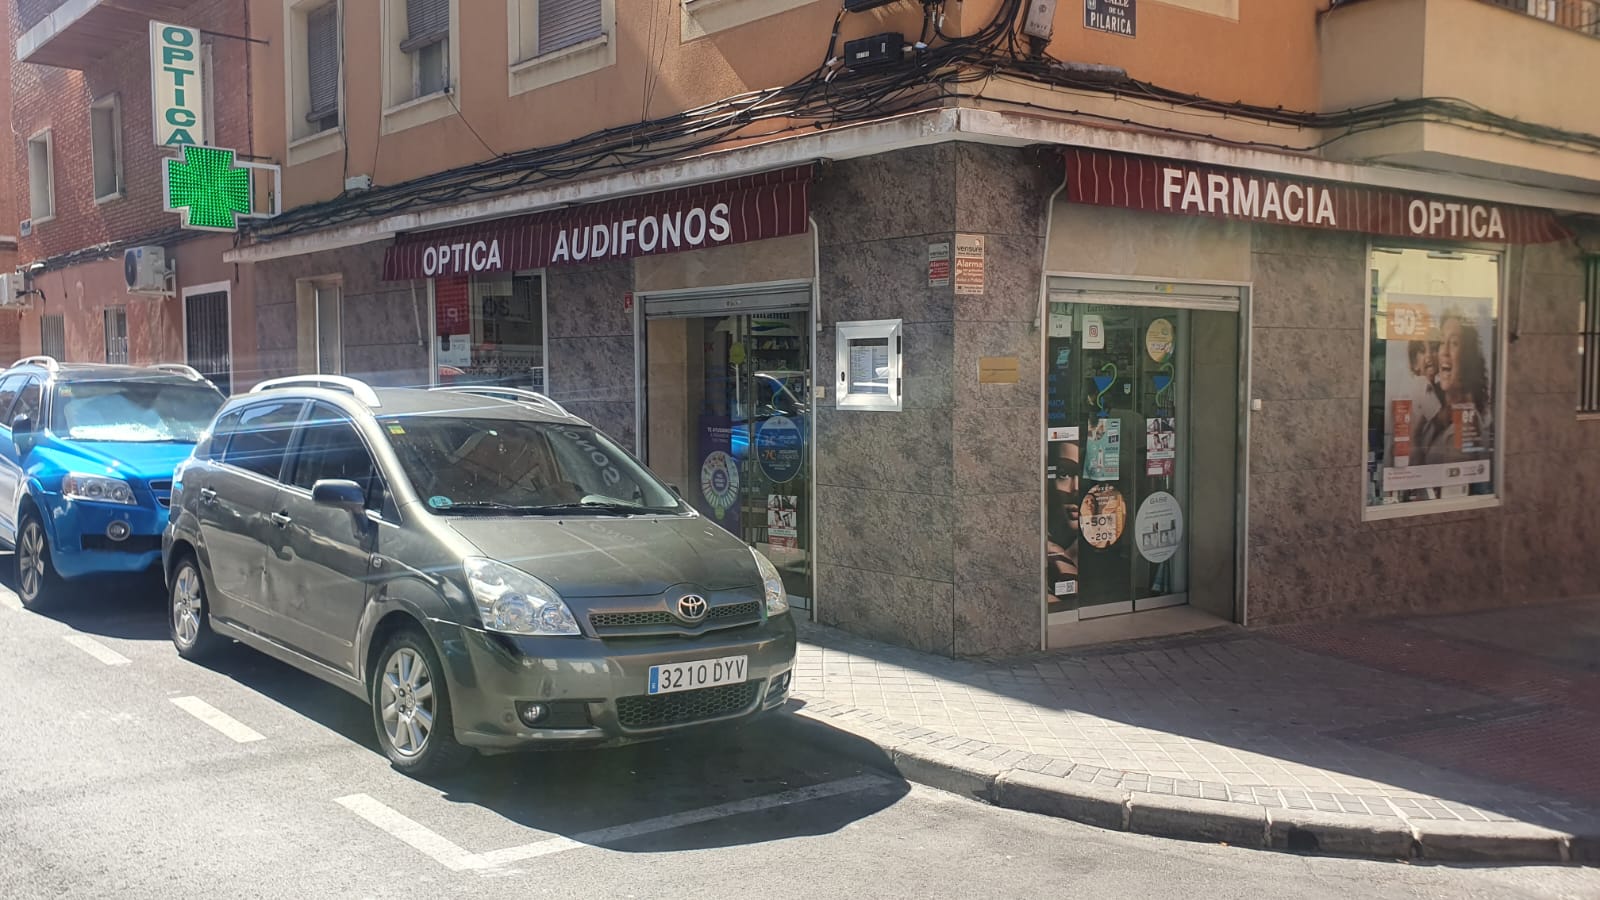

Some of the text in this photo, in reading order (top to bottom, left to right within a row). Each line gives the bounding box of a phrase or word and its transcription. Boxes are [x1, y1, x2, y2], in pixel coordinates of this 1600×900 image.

[1090, 11, 1131, 34] PILARICA
[1108, 6, 1124, 16] DE LA
[162, 26, 196, 145] OPTICA
[1163, 168, 1505, 239] FARMACIA OPTICA
[423, 203, 730, 275] OPTICA AUDIFONOS
[957, 259, 983, 268] Alarma
[661, 659, 745, 689] 3210 DYV
